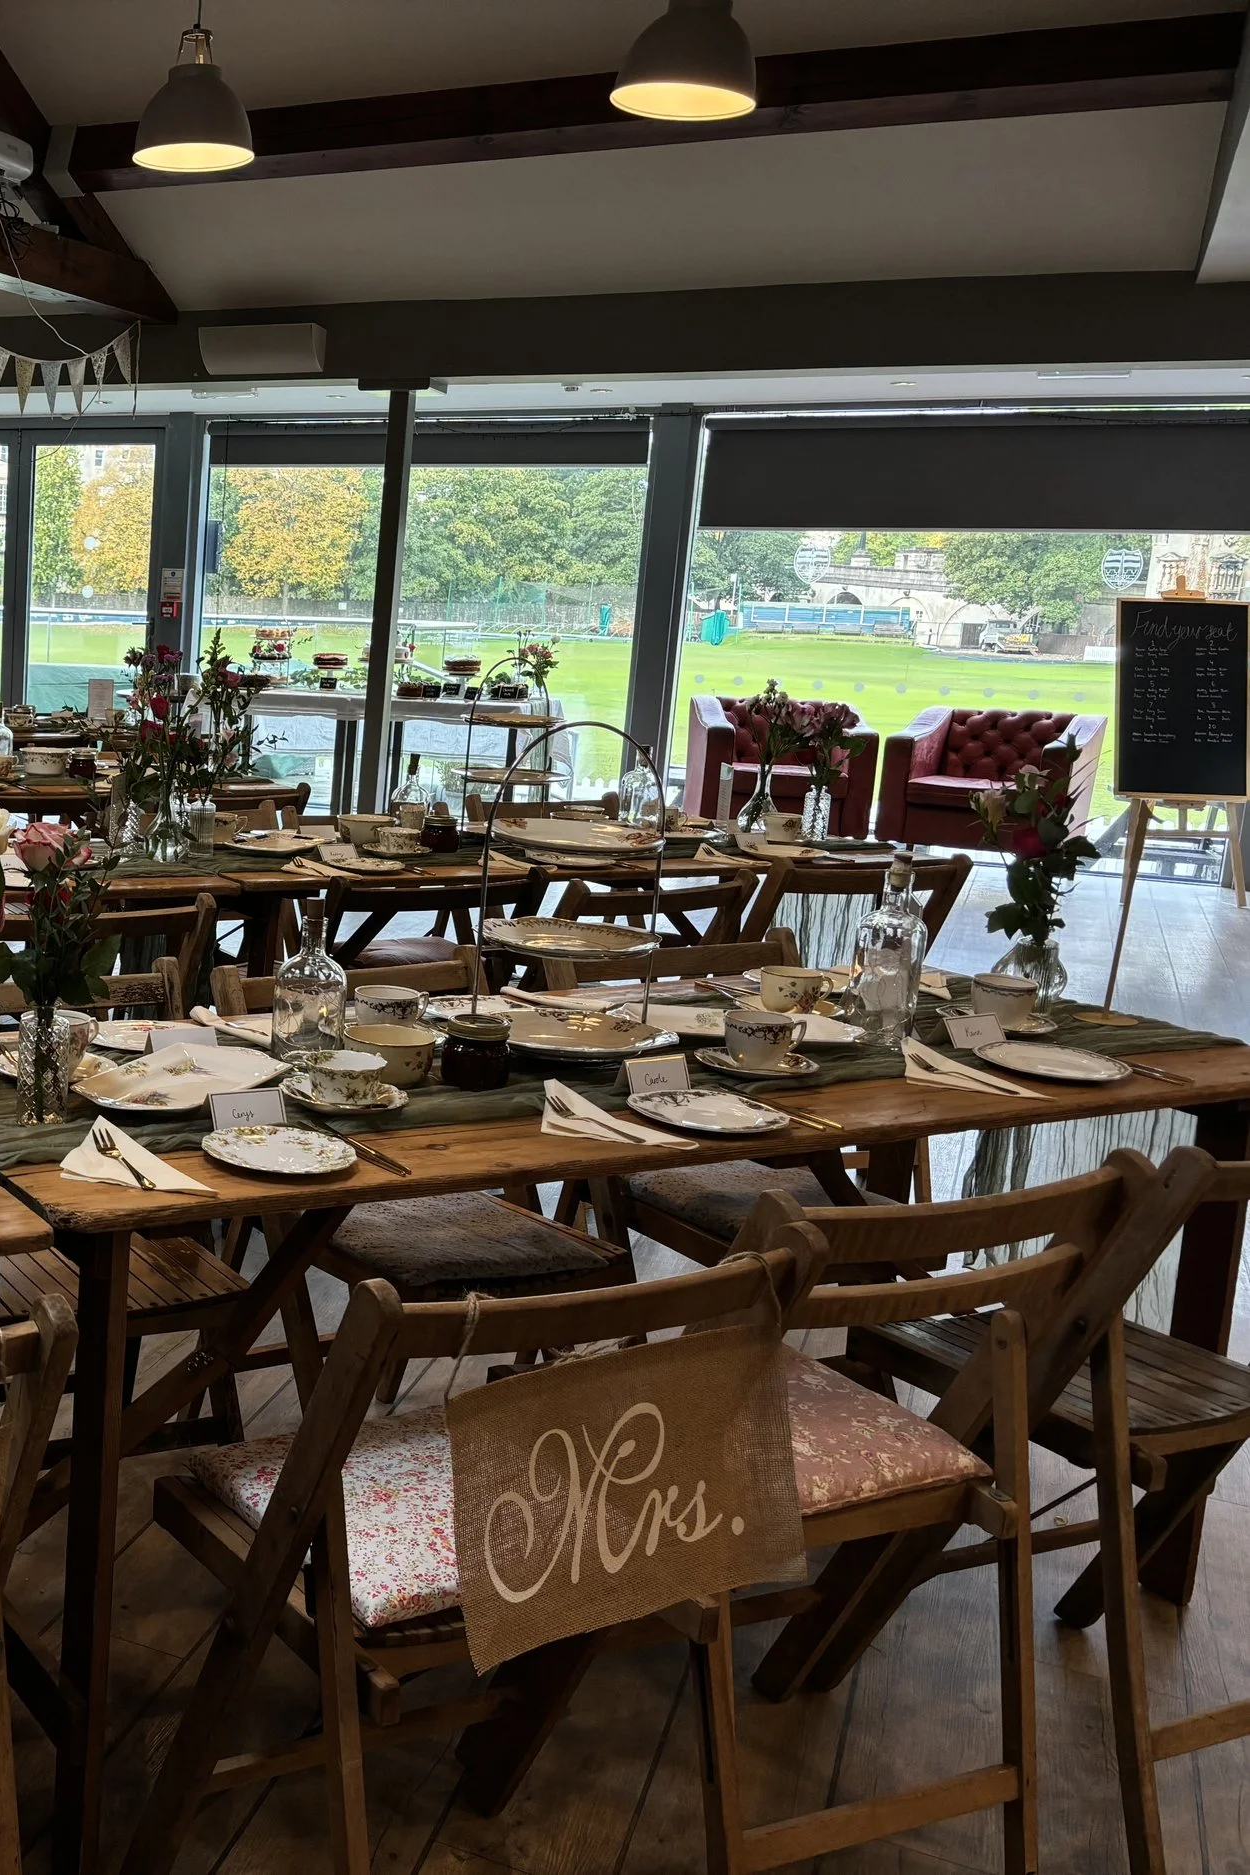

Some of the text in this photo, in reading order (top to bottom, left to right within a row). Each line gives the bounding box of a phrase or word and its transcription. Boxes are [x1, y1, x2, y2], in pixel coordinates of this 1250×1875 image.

[1130, 608, 1171, 639] Find
[1206, 621, 1238, 642] seat
[644, 1072, 668, 1087] Carole
[232, 1108, 254, 1122] Cerys
[484, 1402, 745, 1603] Mrs.
